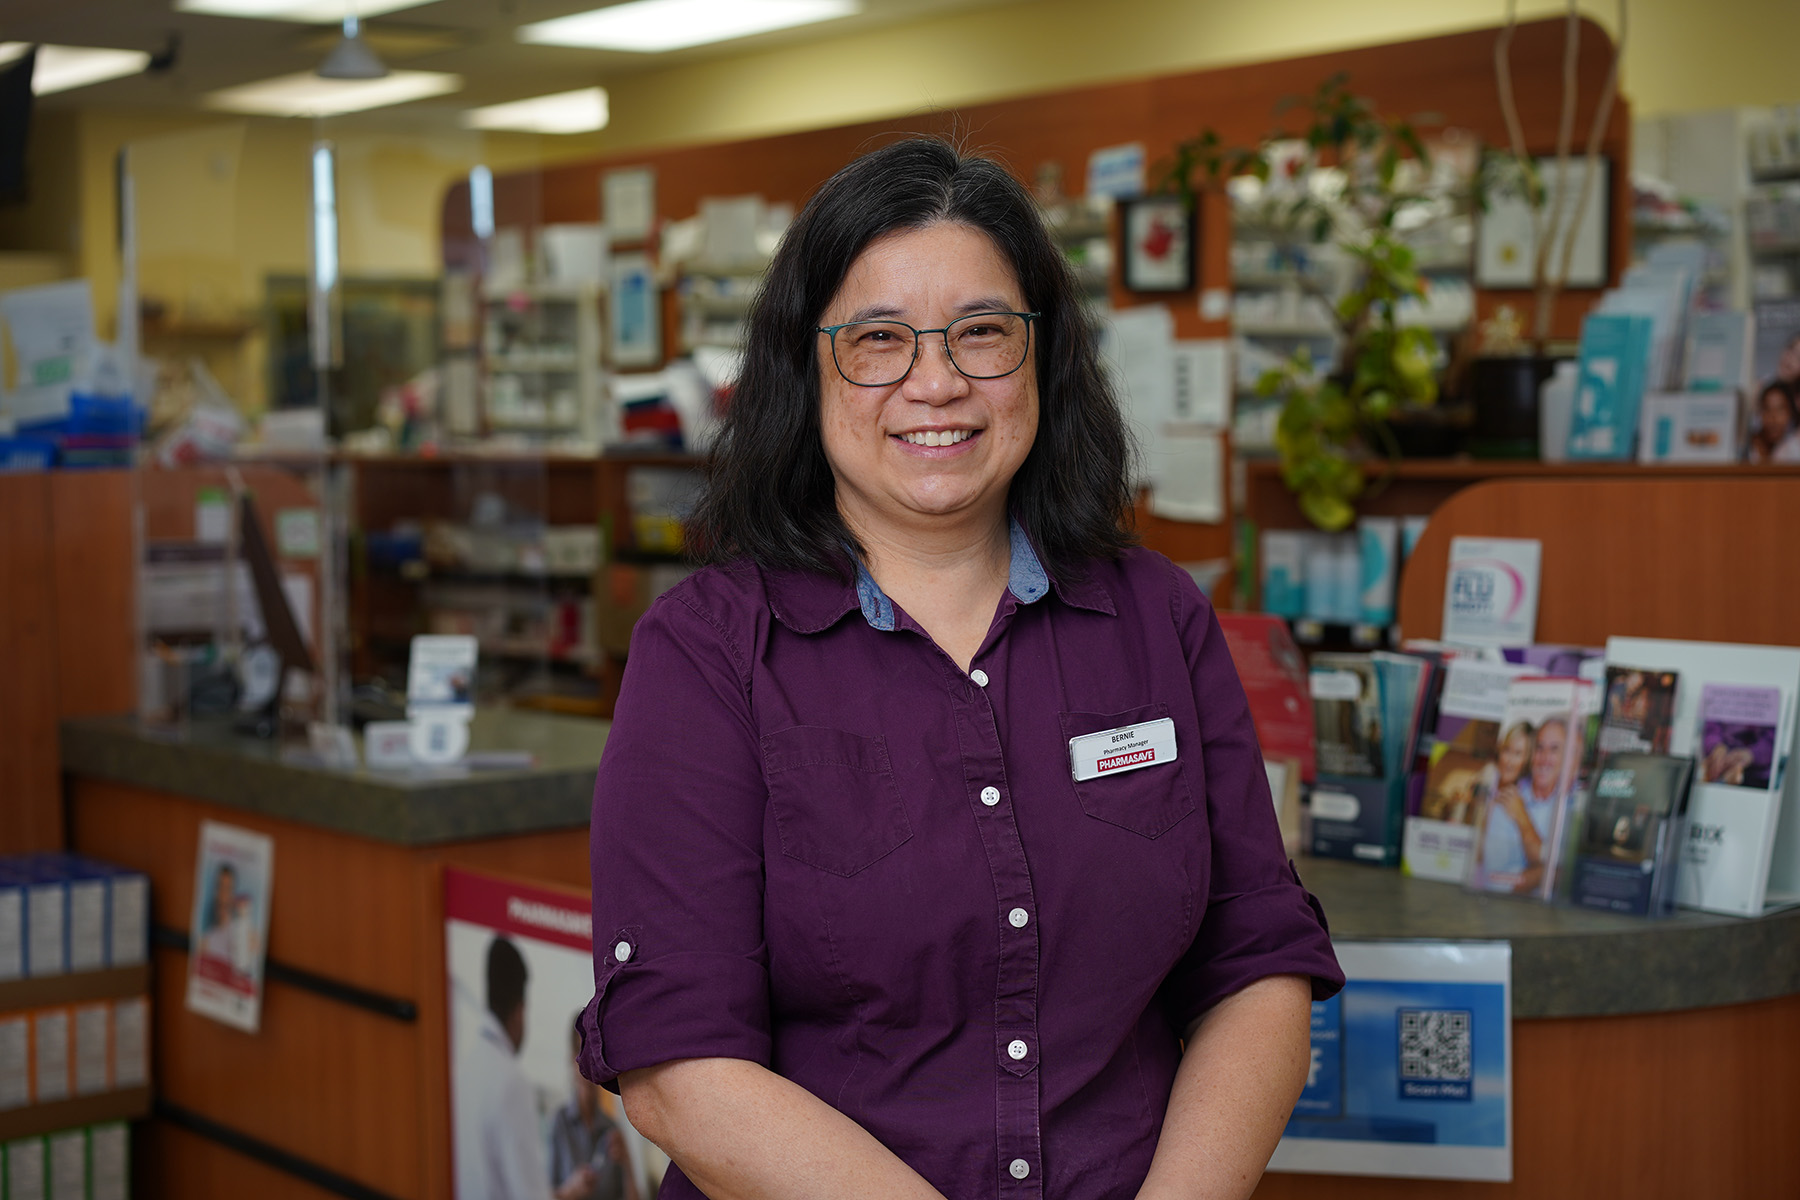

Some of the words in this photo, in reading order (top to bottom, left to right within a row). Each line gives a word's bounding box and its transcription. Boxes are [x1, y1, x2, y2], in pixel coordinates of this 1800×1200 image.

[1111, 731, 1135, 743] BERNIE
[1103, 746, 1127, 755] Pharmacy
[1128, 739, 1149, 748] Manager
[1099, 751, 1154, 770] PHARMASAVE
